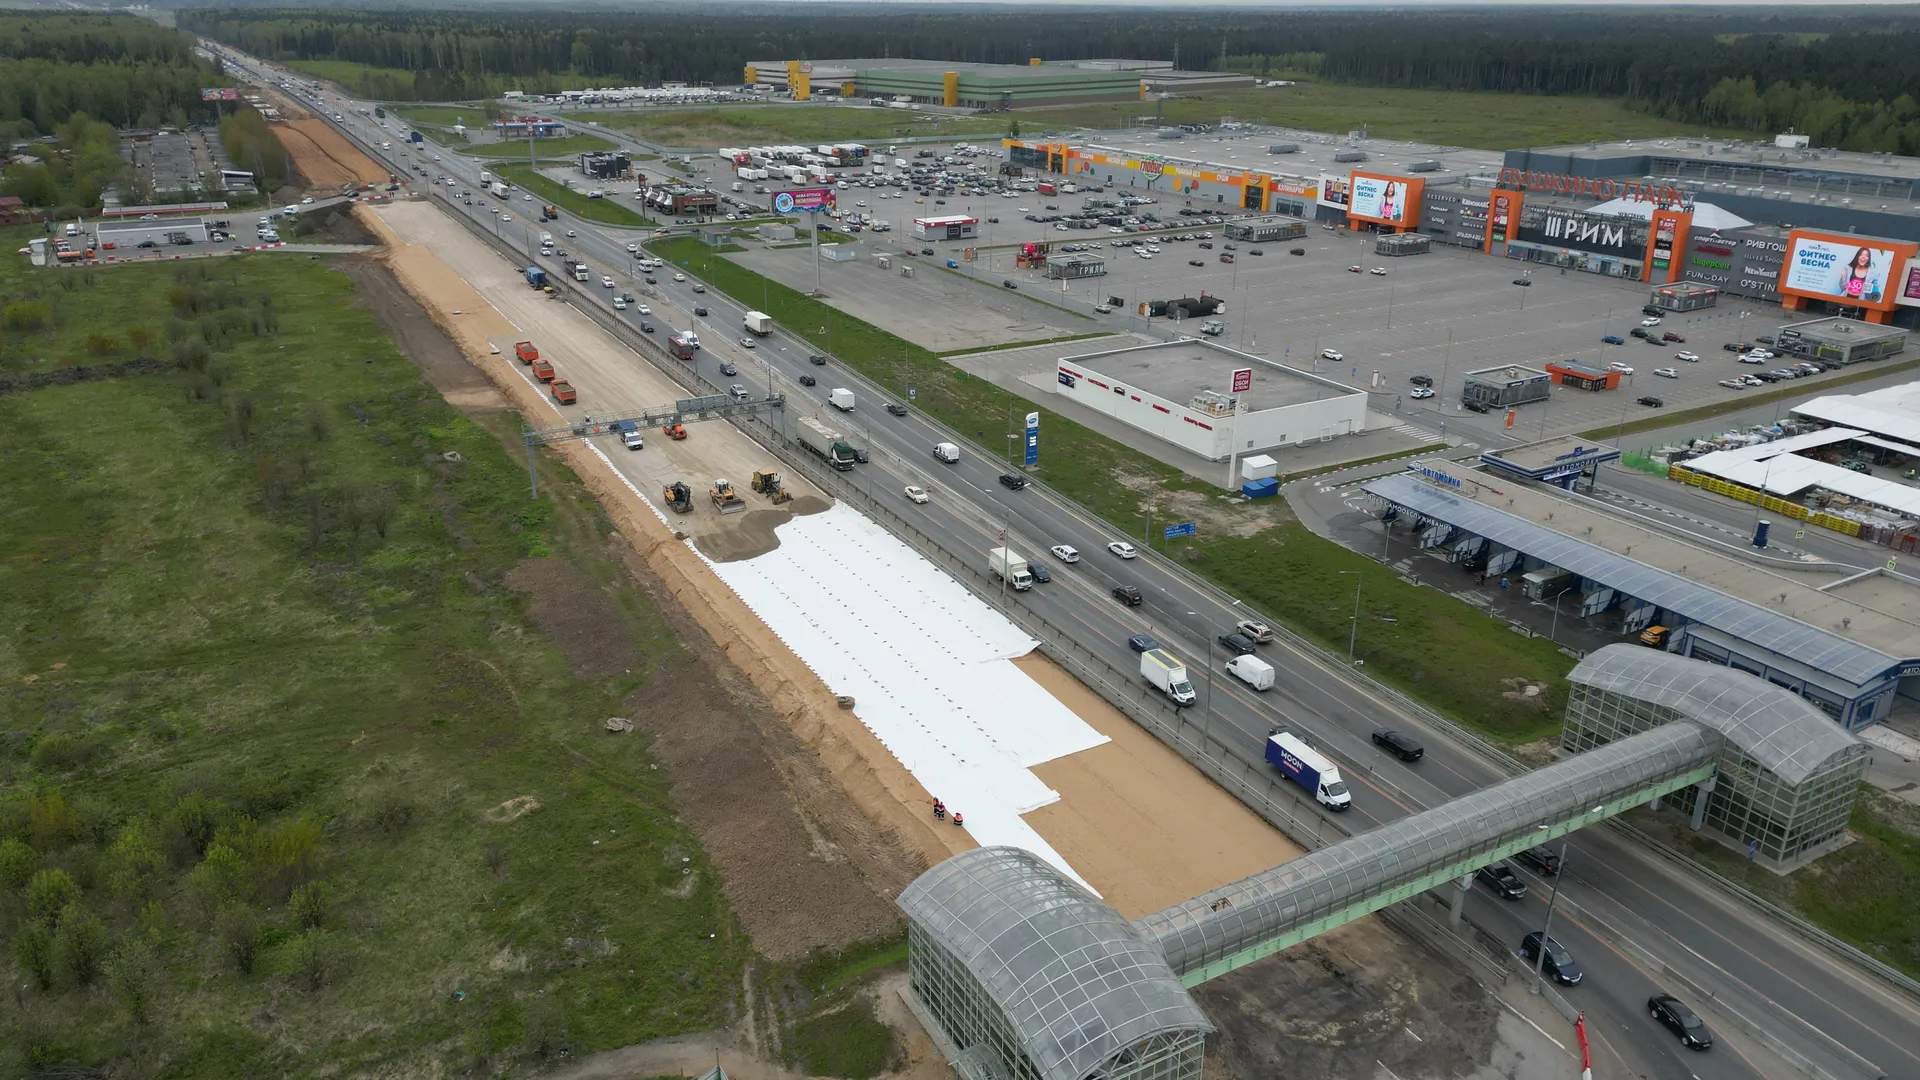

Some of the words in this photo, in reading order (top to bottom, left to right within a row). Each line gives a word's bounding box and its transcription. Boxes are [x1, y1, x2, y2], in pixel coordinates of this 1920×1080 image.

[1356, 185, 1377, 193] ФИТНЕС
[1500, 168, 1615, 200] ПУШКИНО
[1622, 182, 1686, 208] ПАРК
[1357, 191, 1374, 199] ВЕСНА
[1427, 193, 1456, 203] RESERVED
[1746, 239, 1765, 249] РИВ
[1766, 243, 1788, 252] ГОШ
[1799, 249, 1837, 261] ФИТНЕС
[1080, 264, 1104, 275] ГРИЛИ
[1801, 258, 1831, 269] ВЕСНА
[1686, 270, 1703, 279] FUN
[1711, 274, 1729, 283] DAY
[1556, 458, 1599, 473] АВТОМОЙКА
[1422, 467, 1462, 488] АВТОМОЙКА
[1385, 501, 1453, 532] САМООБСЛУЖИВАНИЯ
[1281, 749, 1303, 770] MOON
